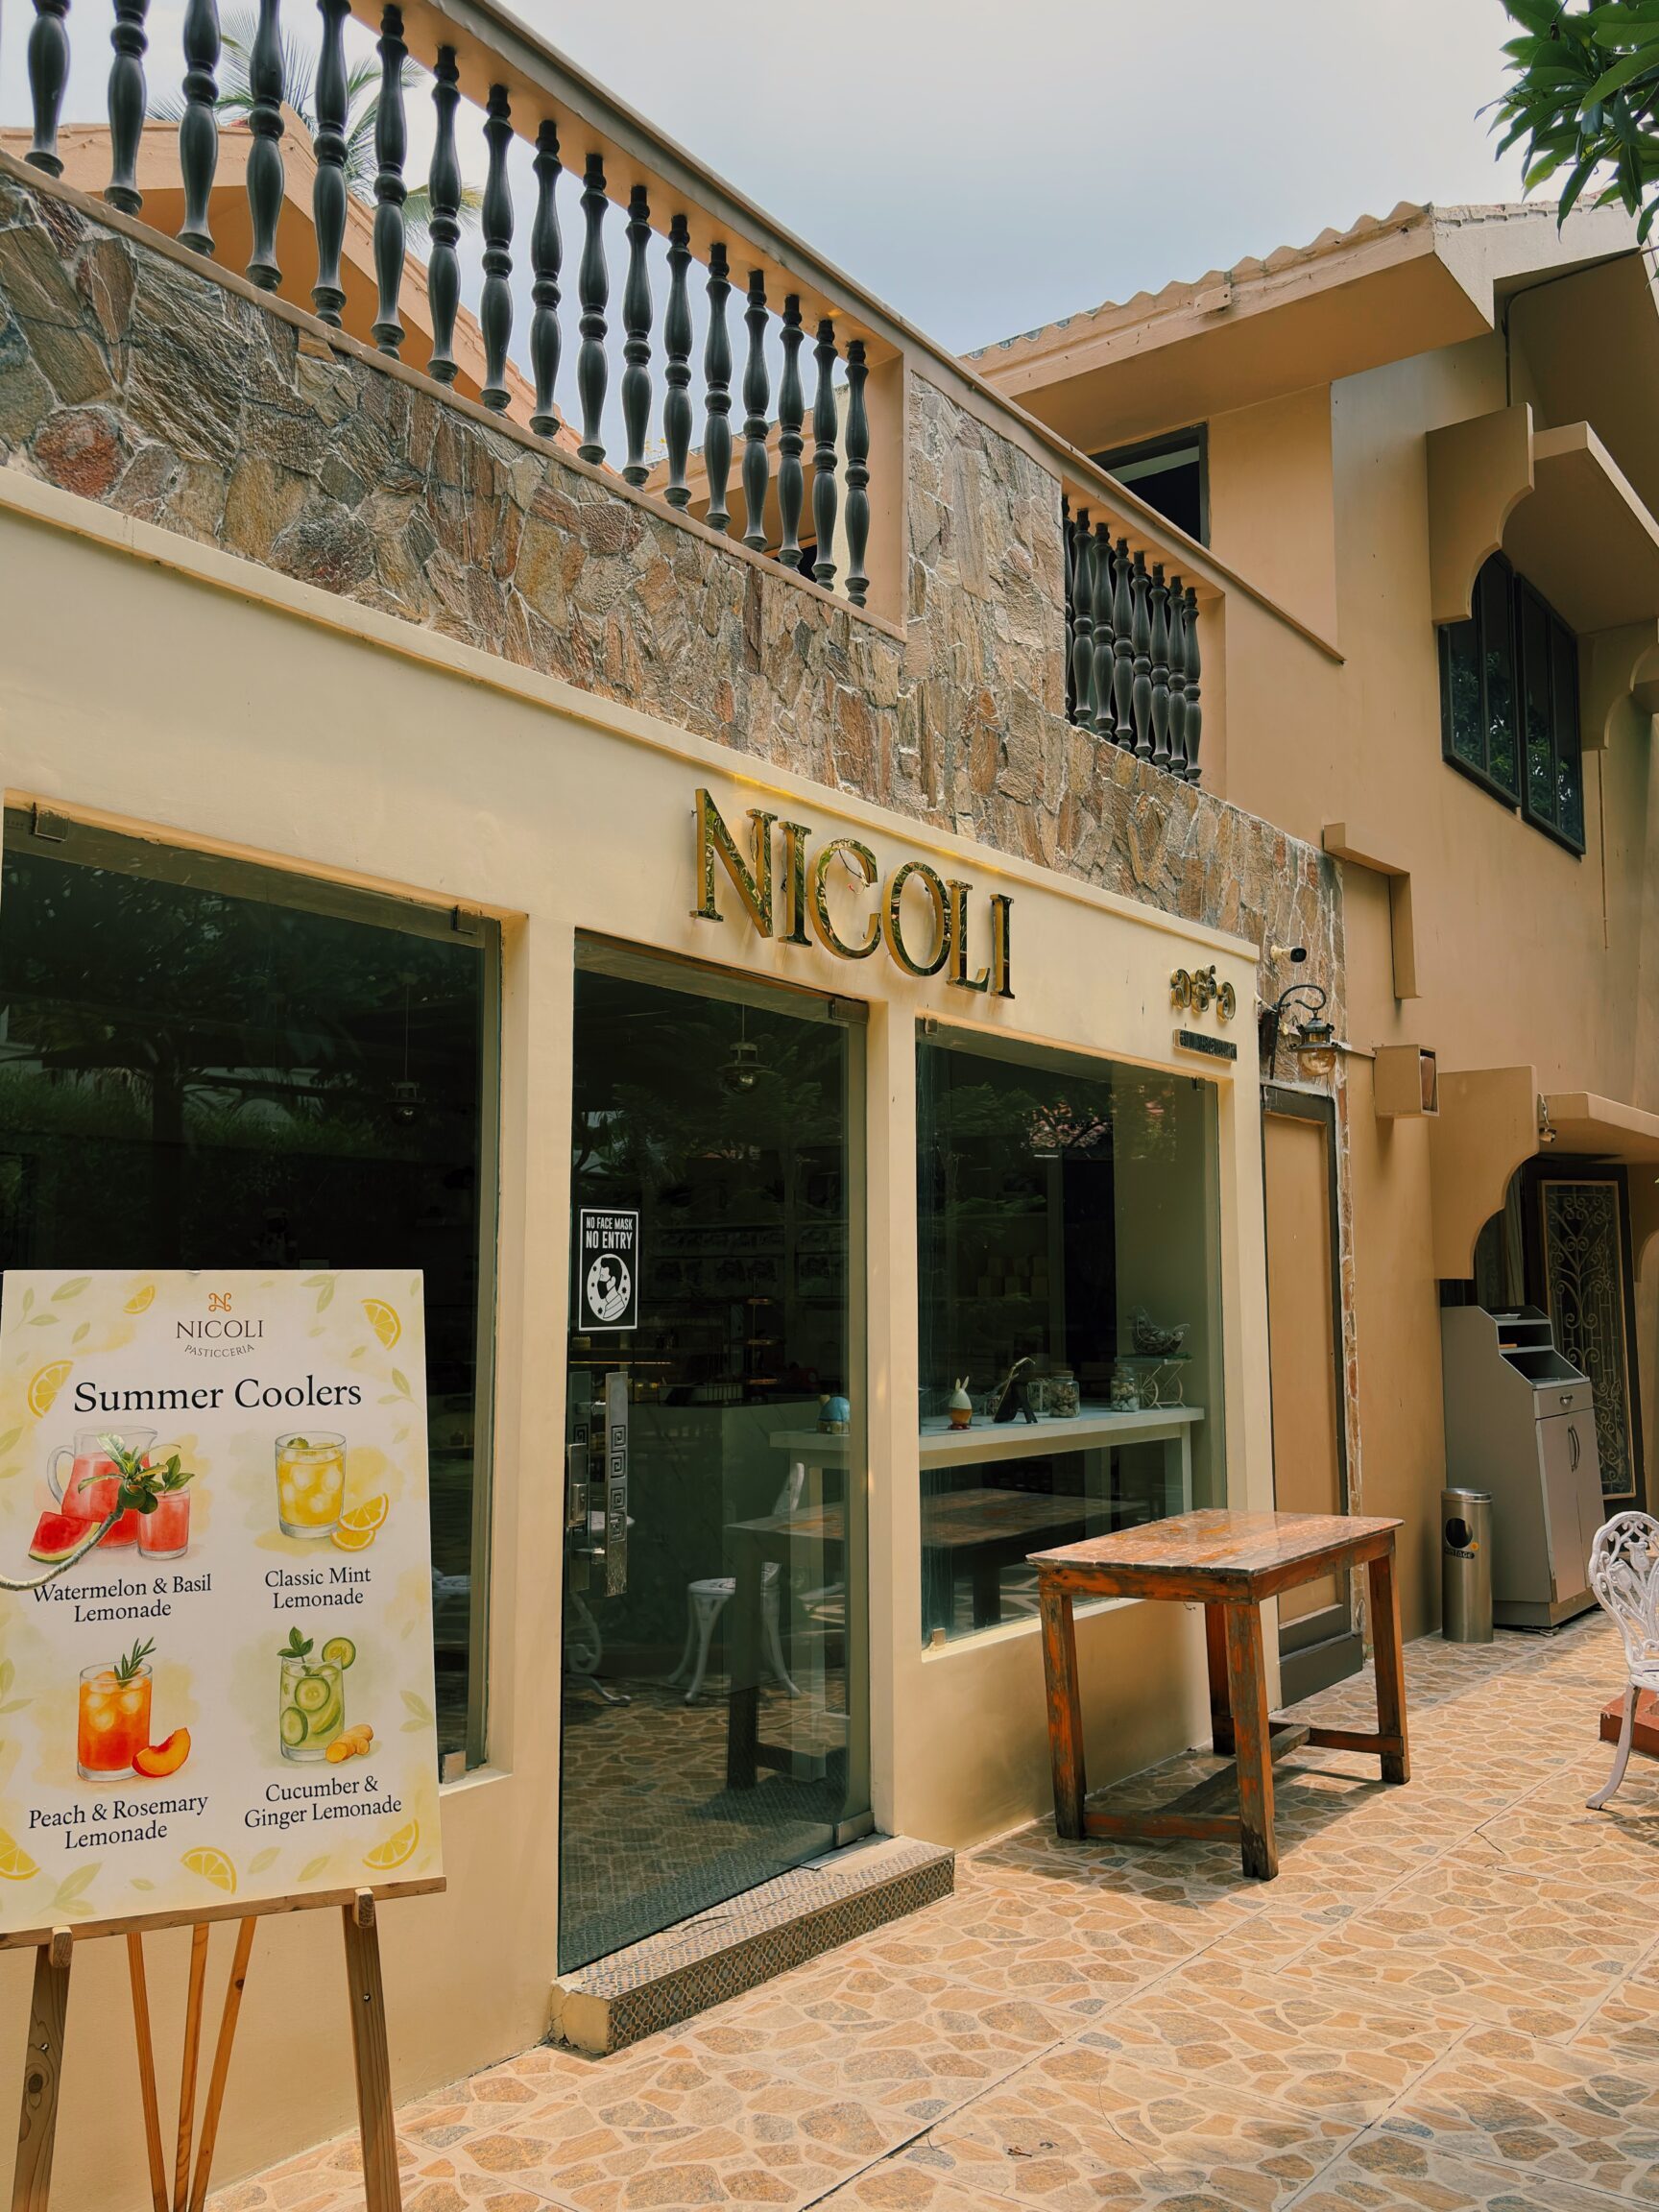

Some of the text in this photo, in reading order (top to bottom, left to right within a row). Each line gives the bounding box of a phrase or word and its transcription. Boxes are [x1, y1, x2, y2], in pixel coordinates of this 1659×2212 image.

[688, 787, 1015, 1000] NICOLI
[586, 1216, 633, 1231] NO FACE MASK
[586, 1230, 633, 1250] NO ENTRY
[176, 1319, 264, 1339] NICOLI
[184, 1343, 254, 1358] PASTICCERIA
[74, 1374, 362, 1412] Summer Coolers
[34, 1573, 212, 1602] Watermelon & Basil
[265, 1566, 372, 1588] Classic Mint
[273, 1587, 364, 1609] Lemonade
[74, 1599, 172, 1623] Lemonade
[266, 1775, 379, 1802] Cucumber &
[29, 1796, 209, 1829] Peach & Rosemary
[244, 1794, 402, 1830] Ginger Lemonade
[64, 1819, 168, 1849] Lemonade
